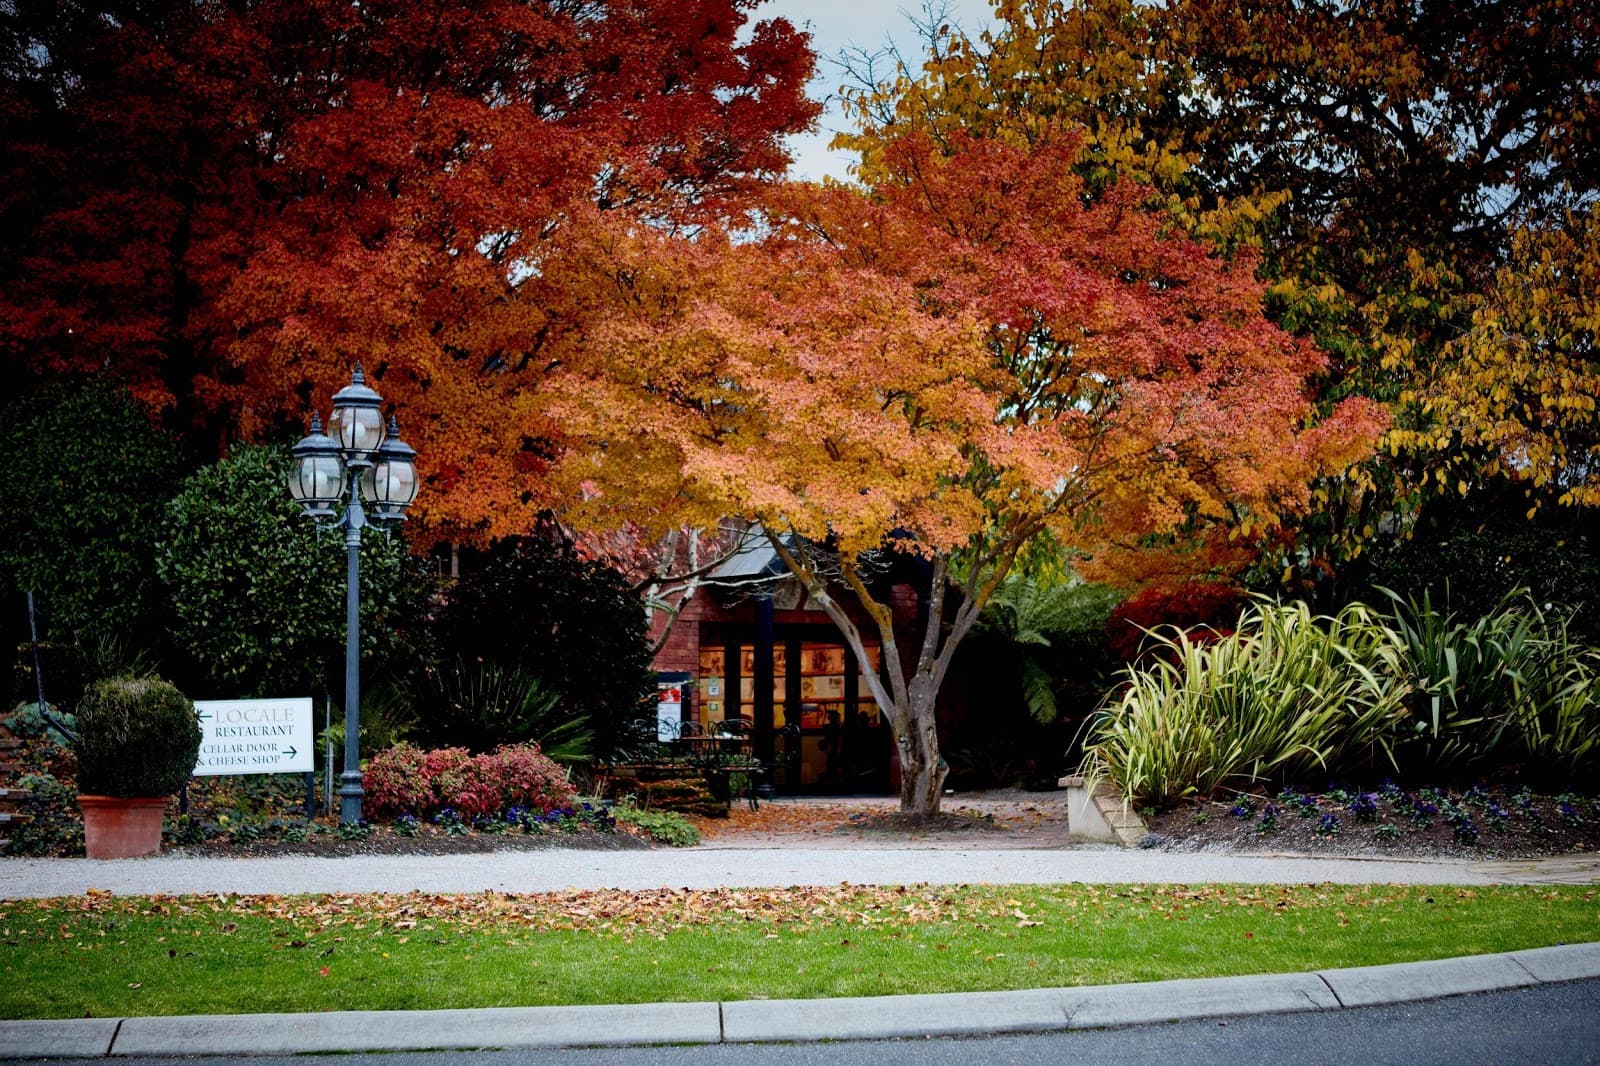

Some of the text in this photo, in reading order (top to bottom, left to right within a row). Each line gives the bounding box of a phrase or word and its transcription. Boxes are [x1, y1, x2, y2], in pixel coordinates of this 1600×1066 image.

[215, 708, 294, 723] LOCALE
[215, 725, 294, 737] RESTAURANT
[203, 743, 278, 754] CELLAR DOOR
[208, 756, 248, 766] CHEESE
[252, 755, 281, 765] SHOP
